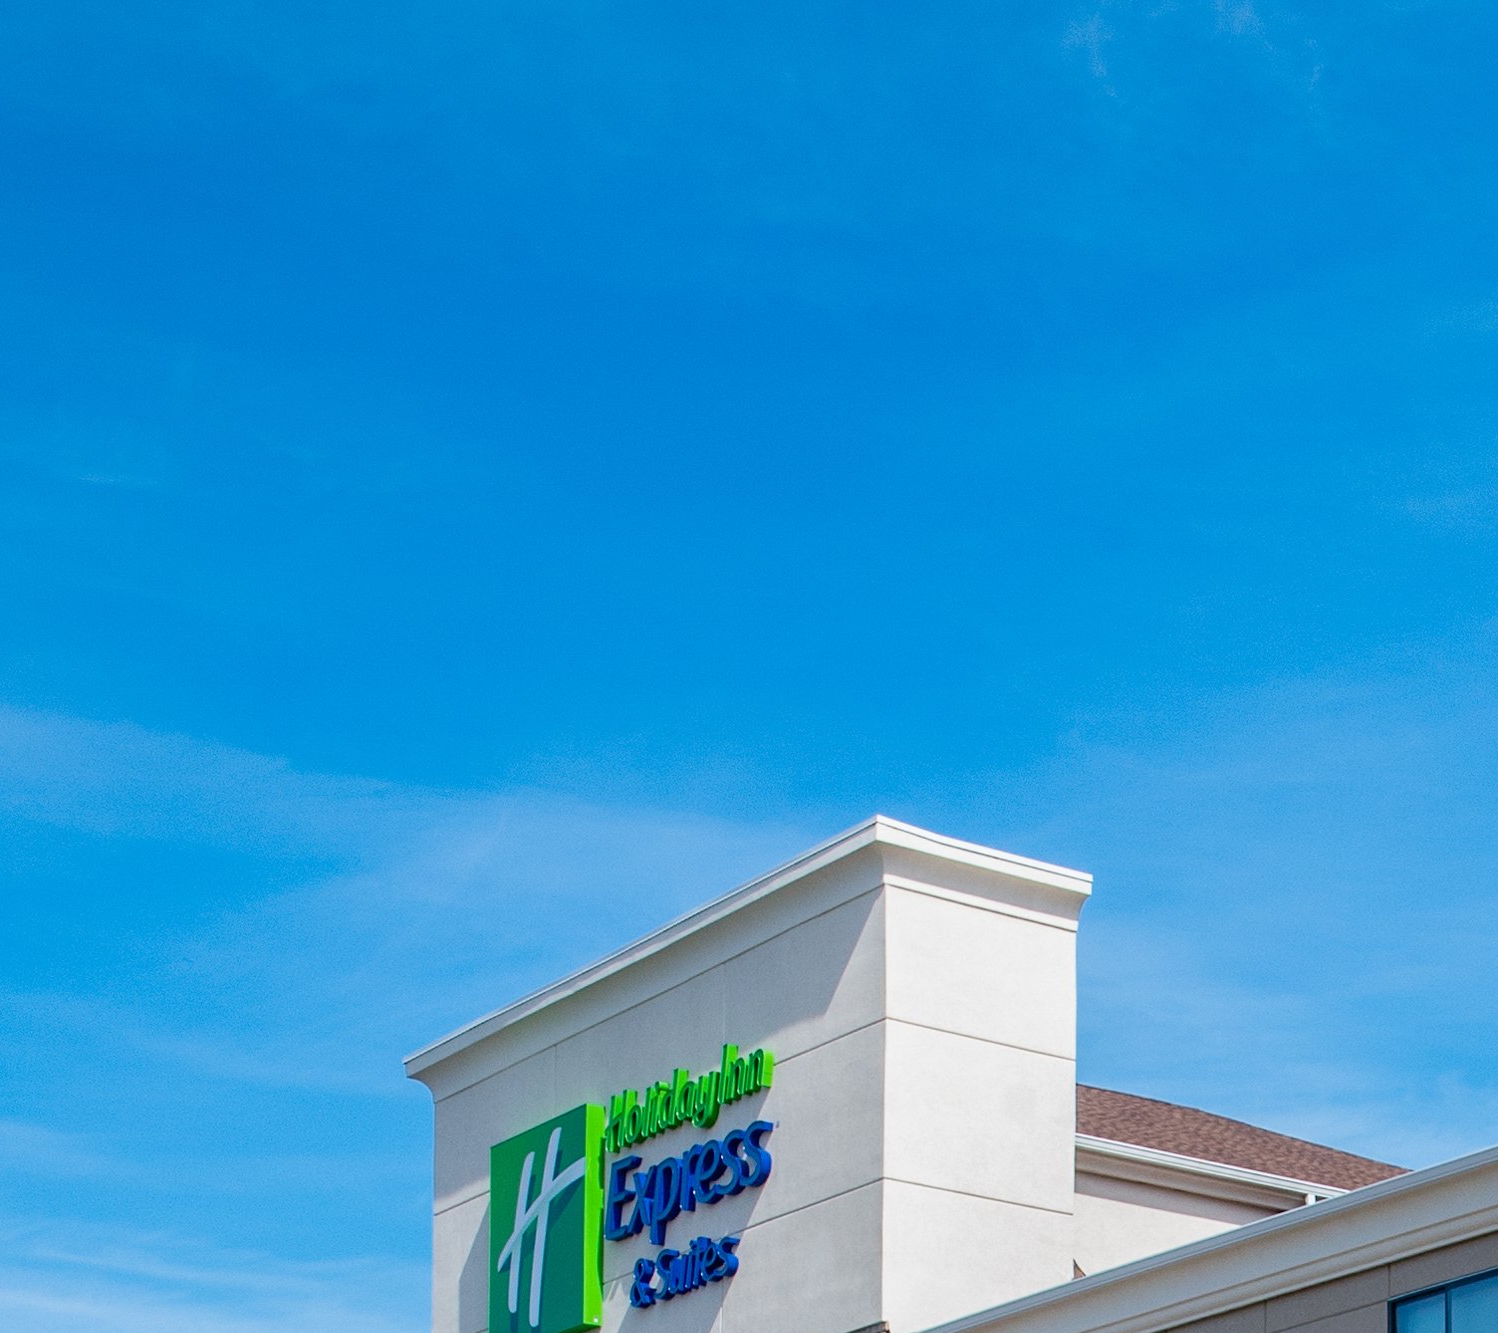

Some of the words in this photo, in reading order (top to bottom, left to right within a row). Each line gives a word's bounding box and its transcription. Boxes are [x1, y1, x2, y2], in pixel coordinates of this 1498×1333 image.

[605, 1068, 720, 1153] Holiday
[717, 1043, 775, 1105] Inn
[603, 1120, 775, 1247] Express
[630, 1258, 657, 1309] &
[654, 1236, 741, 1301] Suites
